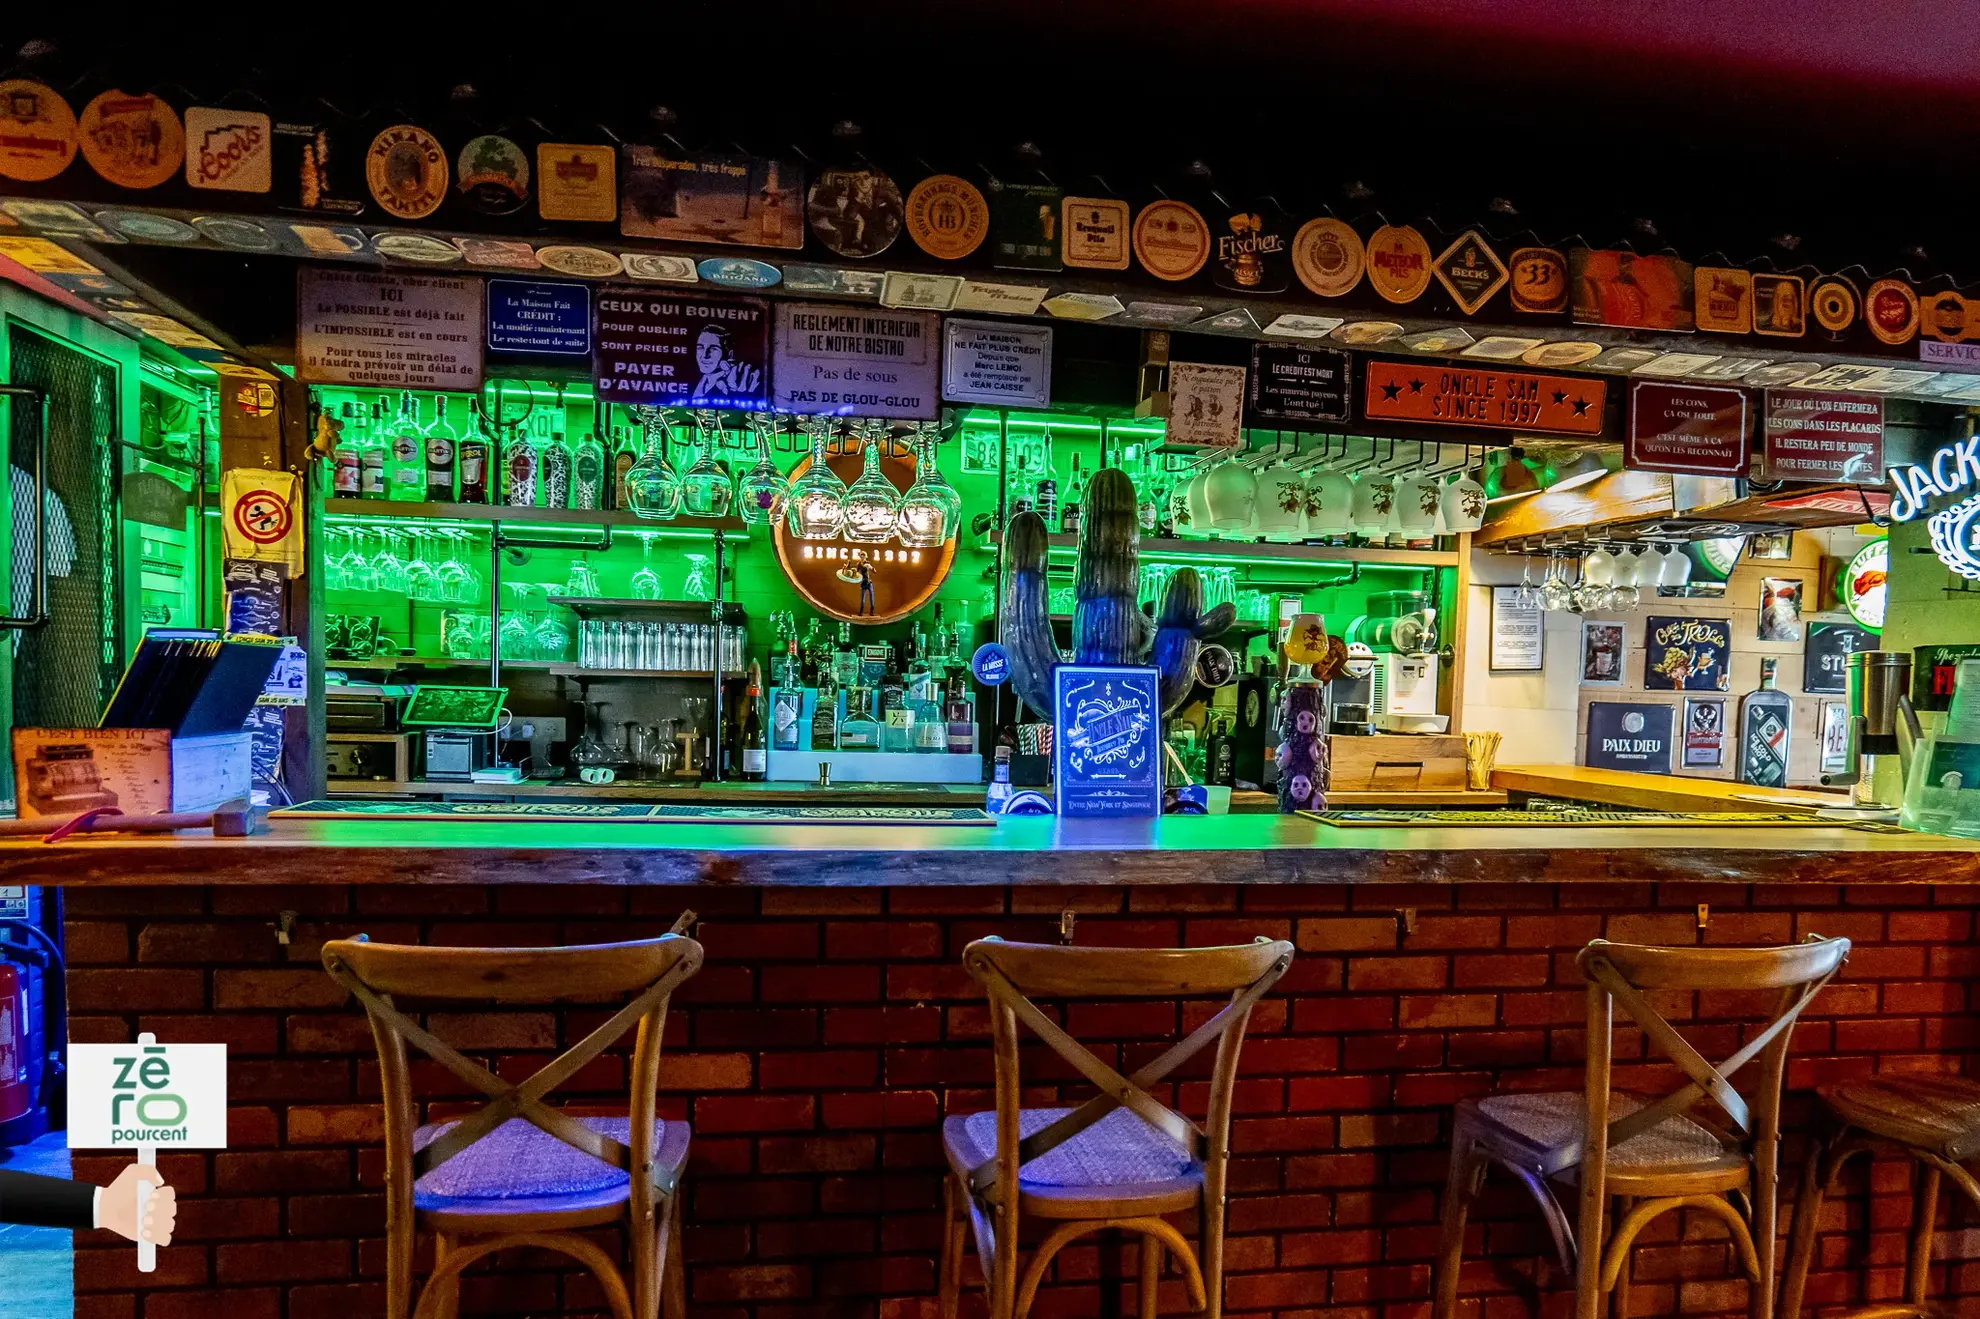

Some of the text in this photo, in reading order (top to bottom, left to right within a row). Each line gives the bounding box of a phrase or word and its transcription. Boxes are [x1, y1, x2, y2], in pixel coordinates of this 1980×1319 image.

[1217, 233, 1286, 261] Fischer
[712, 273, 769, 284] BRIGAND
[380, 288, 404, 302] ICI
[507, 297, 571, 310] La Maison Fait
[318, 302, 465, 322] Le POSSIBLE est déjà fait
[517, 309, 556, 321] CRÉDIT
[600, 300, 760, 322] CEUX QUI BOIVENT
[492, 321, 504, 330] La
[602, 322, 688, 336] POUR OUBLIER
[794, 314, 921, 338] REGLEMENT INTERIEUR
[314, 324, 468, 343] L'IMPOSSIBLE est en cours
[976, 333, 1022, 345] LA MAISON
[494, 334, 504, 342] Le
[552, 338, 563, 346] de
[565, 338, 585, 348] suite
[601, 341, 632, 352] SONT
[672, 346, 688, 355] DE
[809, 334, 905, 357] DE NOTRE BISTRO
[326, 346, 457, 363] Pour tous les miracles
[968, 342, 986, 350] FAIT
[989, 344, 1010, 352] PLUS
[1012, 345, 1042, 355] CRÉDIT
[978, 352, 1003, 362] Depuis
[1298, 354, 1310, 364] ICI
[308, 356, 474, 376] il faudra prévoir un délai de
[614, 362, 675, 377] PAYER
[974, 362, 1022, 372] Marc LEMOI
[1281, 364, 1303, 376] CRÉDIT
[1303, 366, 1317, 377] EST
[1318, 368, 1334, 378] MORT
[348, 370, 436, 384] quelques jours
[813, 365, 898, 384] Pas de sous
[984, 372, 1018, 381] remplacé
[600, 377, 689, 395] D'AVANCE
[970, 381, 1024, 392] JEAN CAISSE
[1265, 384, 1279, 394] Les
[1280, 388, 1310, 397] mauvais
[1440, 373, 1539, 402] ONCLE SAM
[790, 390, 920, 408] PAS DE GLOU-GLOU
[1672, 397, 1684, 407] LES
[1771, 397, 1878, 414] LE JOUR OÙ L'ON ENFERMERA
[1432, 396, 1542, 424] SINCE 1997
[1664, 409, 1676, 420] ÇA
[1768, 417, 1882, 434] LES CONS DANS LES PLACARDS
[1656, 434, 1677, 444] C'EST
[1678, 434, 1702, 445] MÊME
[1711, 438, 1722, 447] ÇA
[1776, 438, 1874, 454] IL RESTERA PEU DE MONDE
[1645, 444, 1733, 458] QU'ON LES RECONNAÎT
[1776, 458, 1842, 472] POUR FERMER LES
[802, 545, 921, 564] SINCE 1997
[1674, 618, 1725, 648] TROLLS
[36, 729, 146, 740] C'EST BIEN ICI
[1602, 738, 1662, 752] PAIX DIEU
[1101, 800, 1113, 810] YORK
